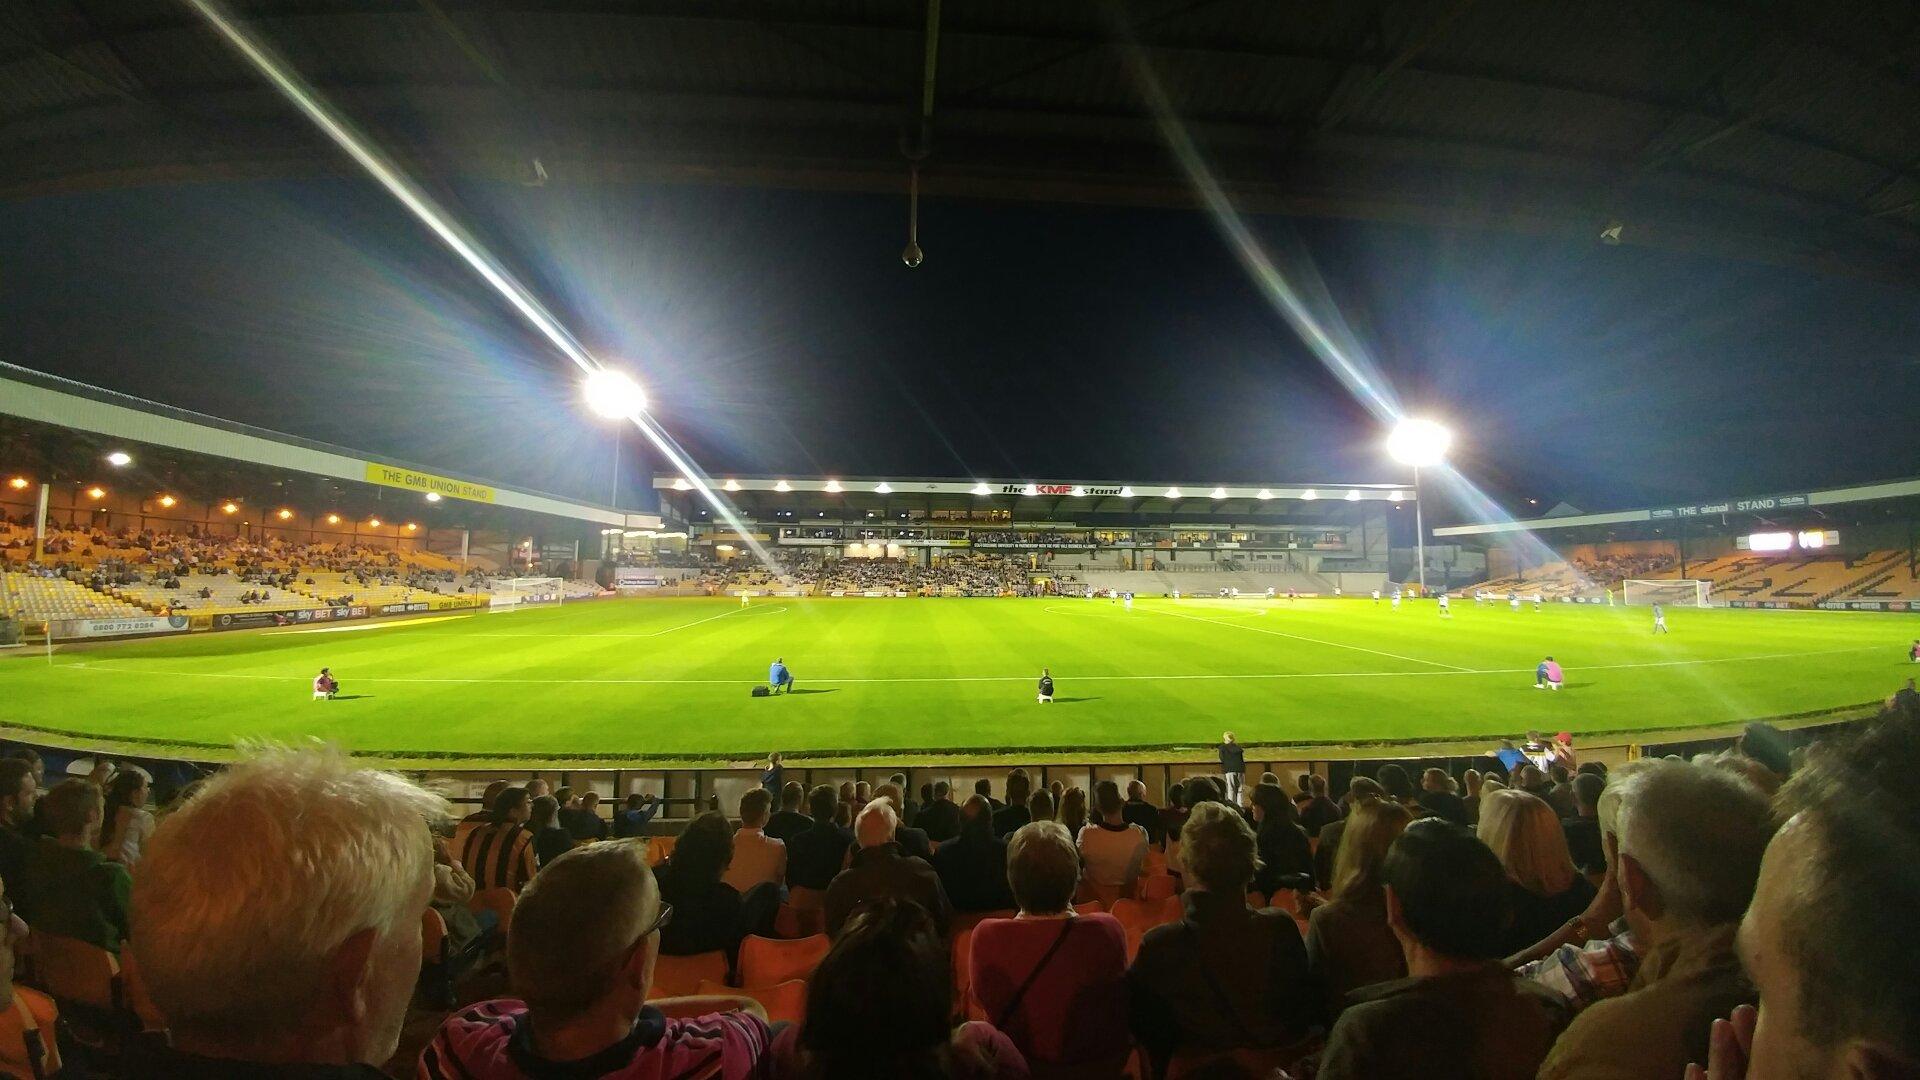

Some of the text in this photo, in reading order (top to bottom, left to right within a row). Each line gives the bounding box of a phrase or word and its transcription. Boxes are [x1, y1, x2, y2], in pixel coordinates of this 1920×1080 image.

[382, 469, 488, 499] THE GMB UNION STAND
[1002, 485, 1027, 493] the
[1036, 485, 1072, 494] KMF
[1677, 506, 1697, 516] THE
[1737, 499, 1775, 511] STAND
[298, 609, 312, 620] sky
[315, 609, 332, 619] BET
[337, 606, 367, 617] sky BET
